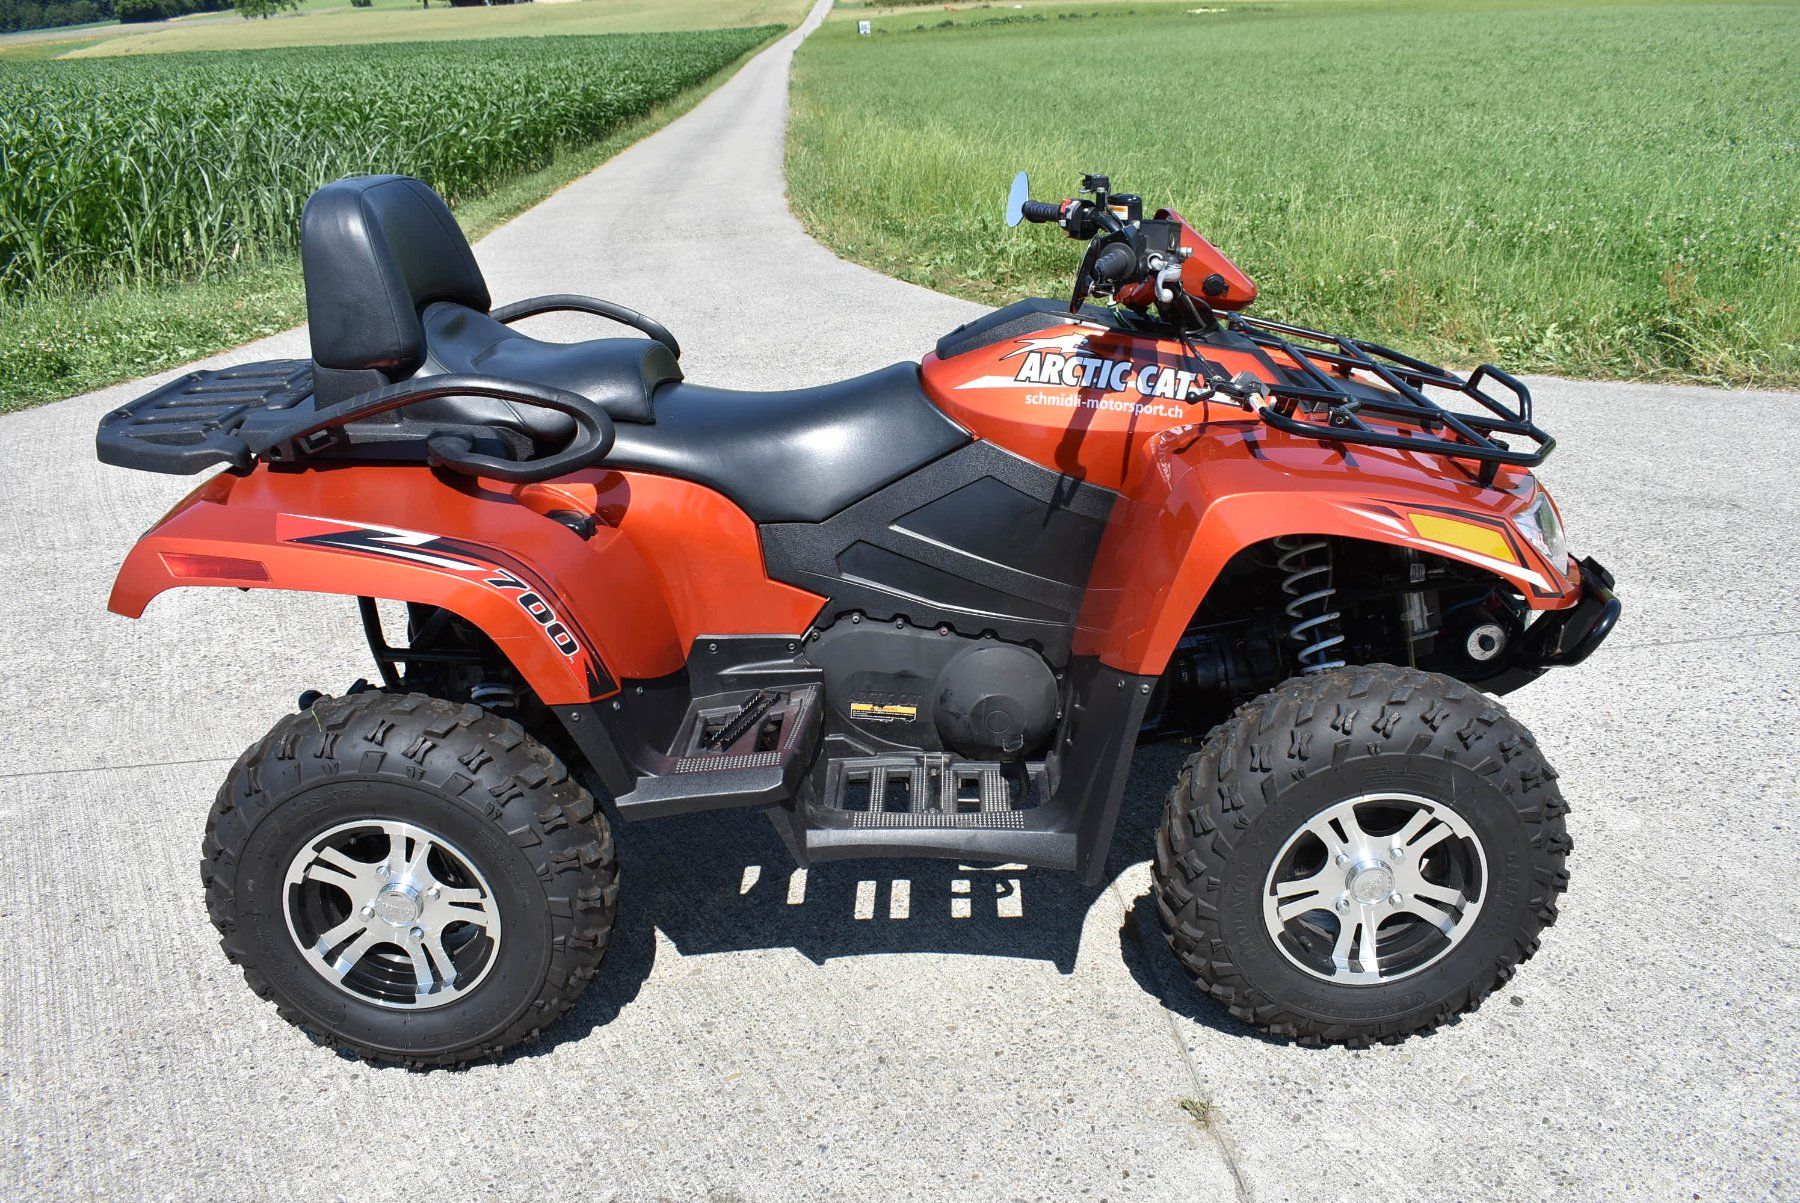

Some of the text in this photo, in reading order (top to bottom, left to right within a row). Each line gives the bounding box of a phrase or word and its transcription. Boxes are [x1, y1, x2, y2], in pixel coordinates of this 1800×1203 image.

[1014, 352, 1196, 400] ARCTIC CAT
[1025, 393, 1183, 418] schmidli-motorsport.ch
[483, 567, 580, 657] 700
